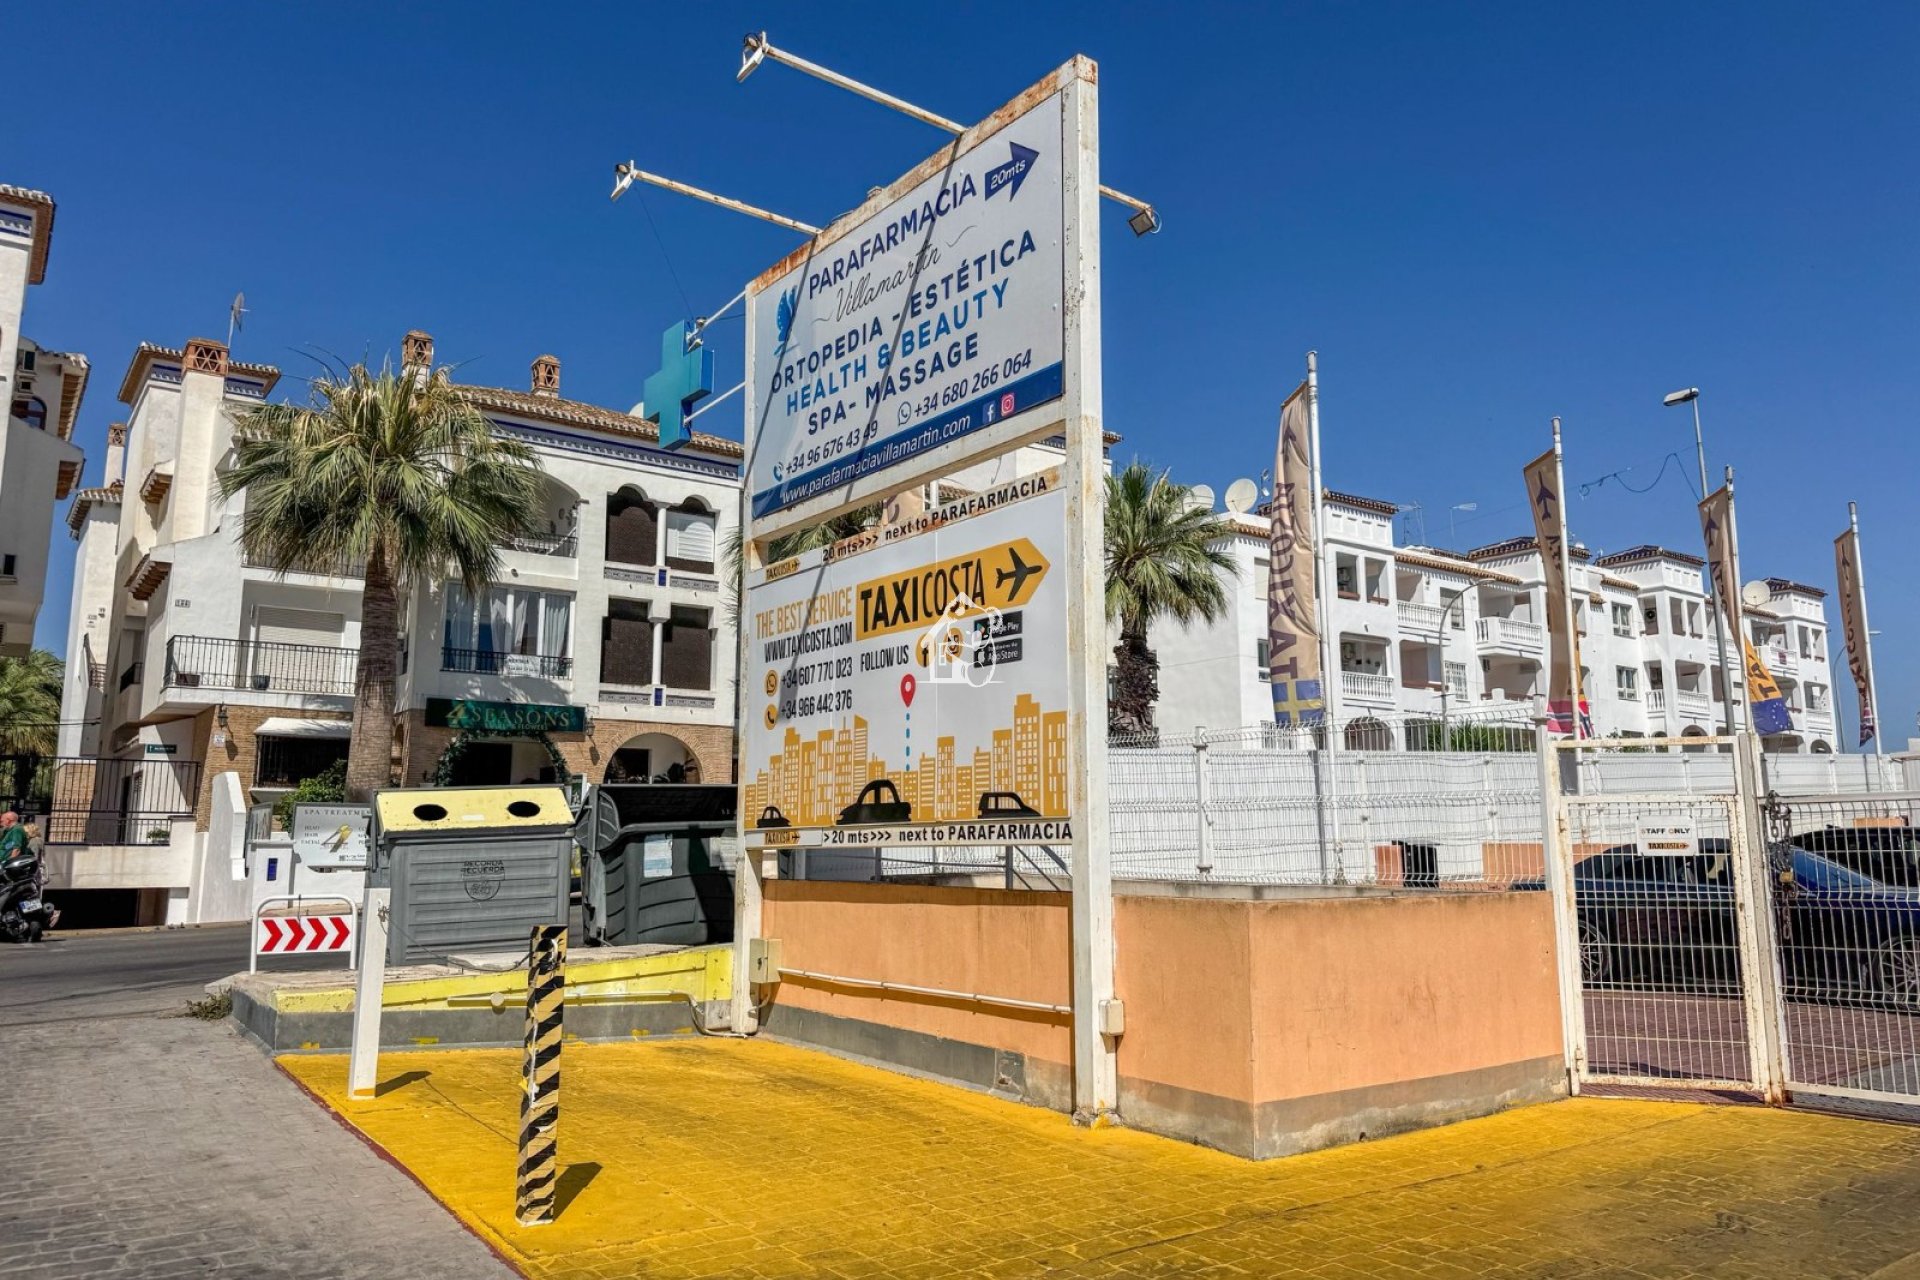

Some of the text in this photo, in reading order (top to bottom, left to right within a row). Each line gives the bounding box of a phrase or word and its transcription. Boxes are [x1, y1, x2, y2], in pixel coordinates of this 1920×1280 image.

[809, 159, 1026, 300] PARAFARMACIA 20mts
[771, 316, 883, 394] ORTOPEDIA
[910, 229, 1036, 320] ESTÉTICA
[786, 278, 1009, 417] HEALTH & BEAUTY
[866, 332, 979, 408] MASSAGE
[914, 348, 1032, 417] +34 680 266 064
[782, 415, 971, 504] www.parafarmaciavillamartin.com
[786, 420, 878, 474] +34 96 676 43 49
[822, 545, 835, 562] 20
[885, 523, 912, 541] next
[914, 516, 928, 531] to
[931, 476, 1047, 526] PARAFARMACIA
[756, 587, 853, 640] THE BEST SERVICE
[860, 557, 986, 633] TAXICOSTA
[764, 622, 853, 663] WWW.TAXICOSTA.COM
[861, 644, 909, 672] FOLLOW US
[1001, 650, 1018, 660] Store
[781, 656, 853, 688] +34 607 770 023
[445, 702, 570, 727] 4 SEASONS
[781, 689, 853, 720] +34 966 442 376
[832, 830, 845, 844] 20
[899, 827, 928, 842] next
[931, 828, 944, 841] to
[948, 823, 1073, 841] PARAFARMACIA
